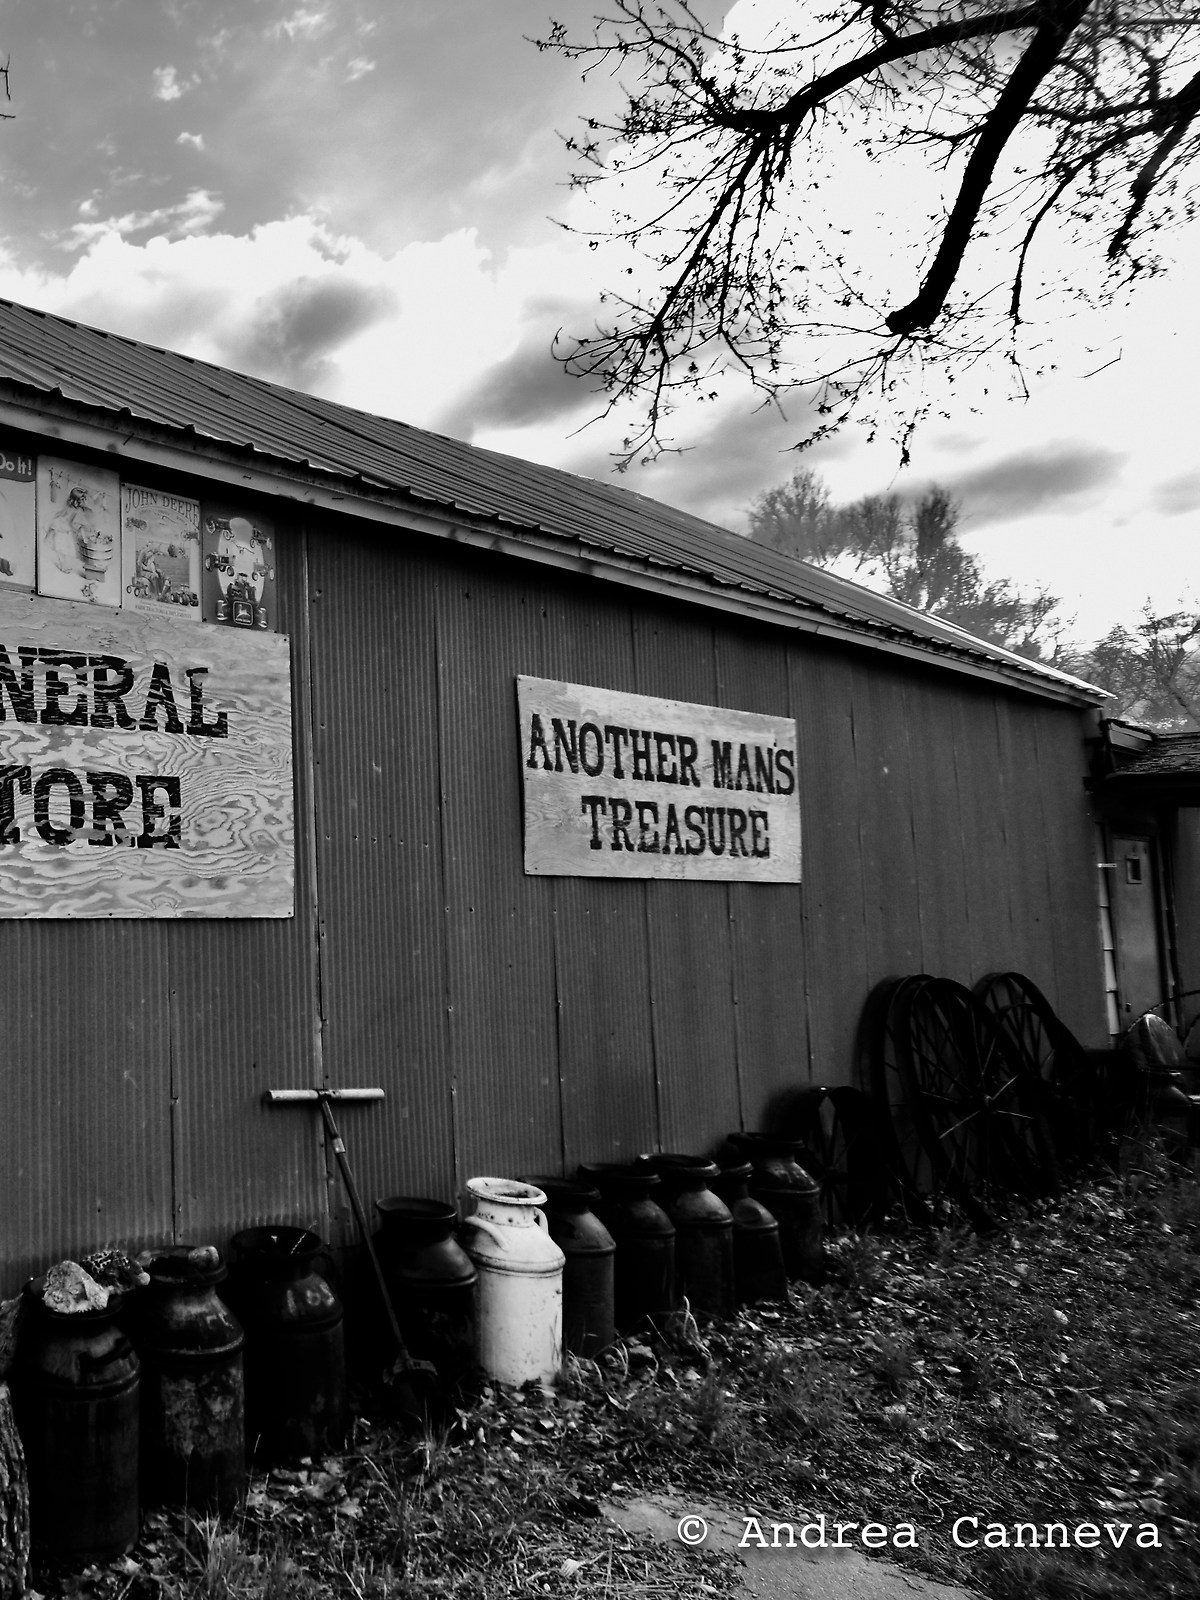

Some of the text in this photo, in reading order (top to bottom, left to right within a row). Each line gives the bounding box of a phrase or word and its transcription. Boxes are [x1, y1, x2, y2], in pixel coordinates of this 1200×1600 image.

[17, 456, 33, 476] It!
[125, 487, 158, 513] JOHN
[163, 495, 200, 530] DEERE
[527, 713, 701, 787] ANOTHER
[581, 795, 770, 858] TREASURE
